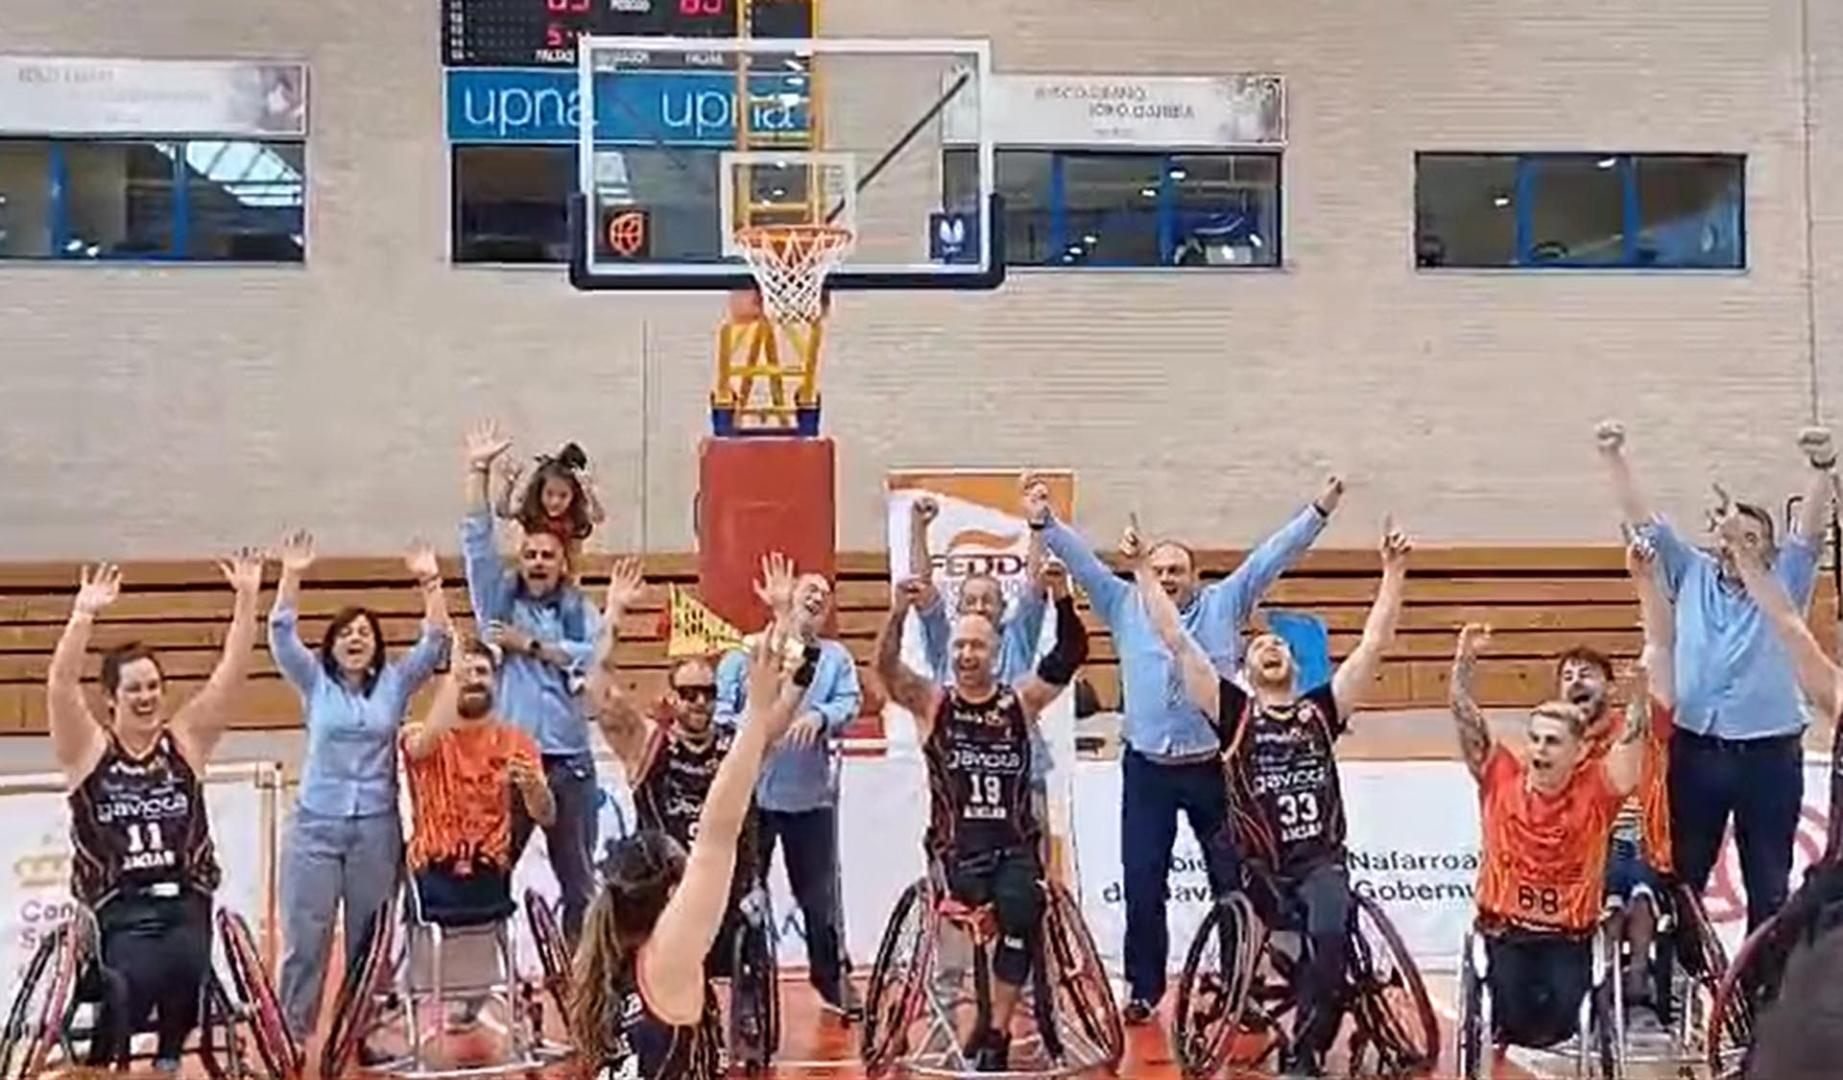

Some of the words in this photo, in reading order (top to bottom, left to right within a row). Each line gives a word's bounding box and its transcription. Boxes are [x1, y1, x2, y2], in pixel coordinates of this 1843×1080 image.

[1278, 792, 1319, 825] 33
[127, 823, 163, 853] 11
[20, 900, 75, 923] Con
